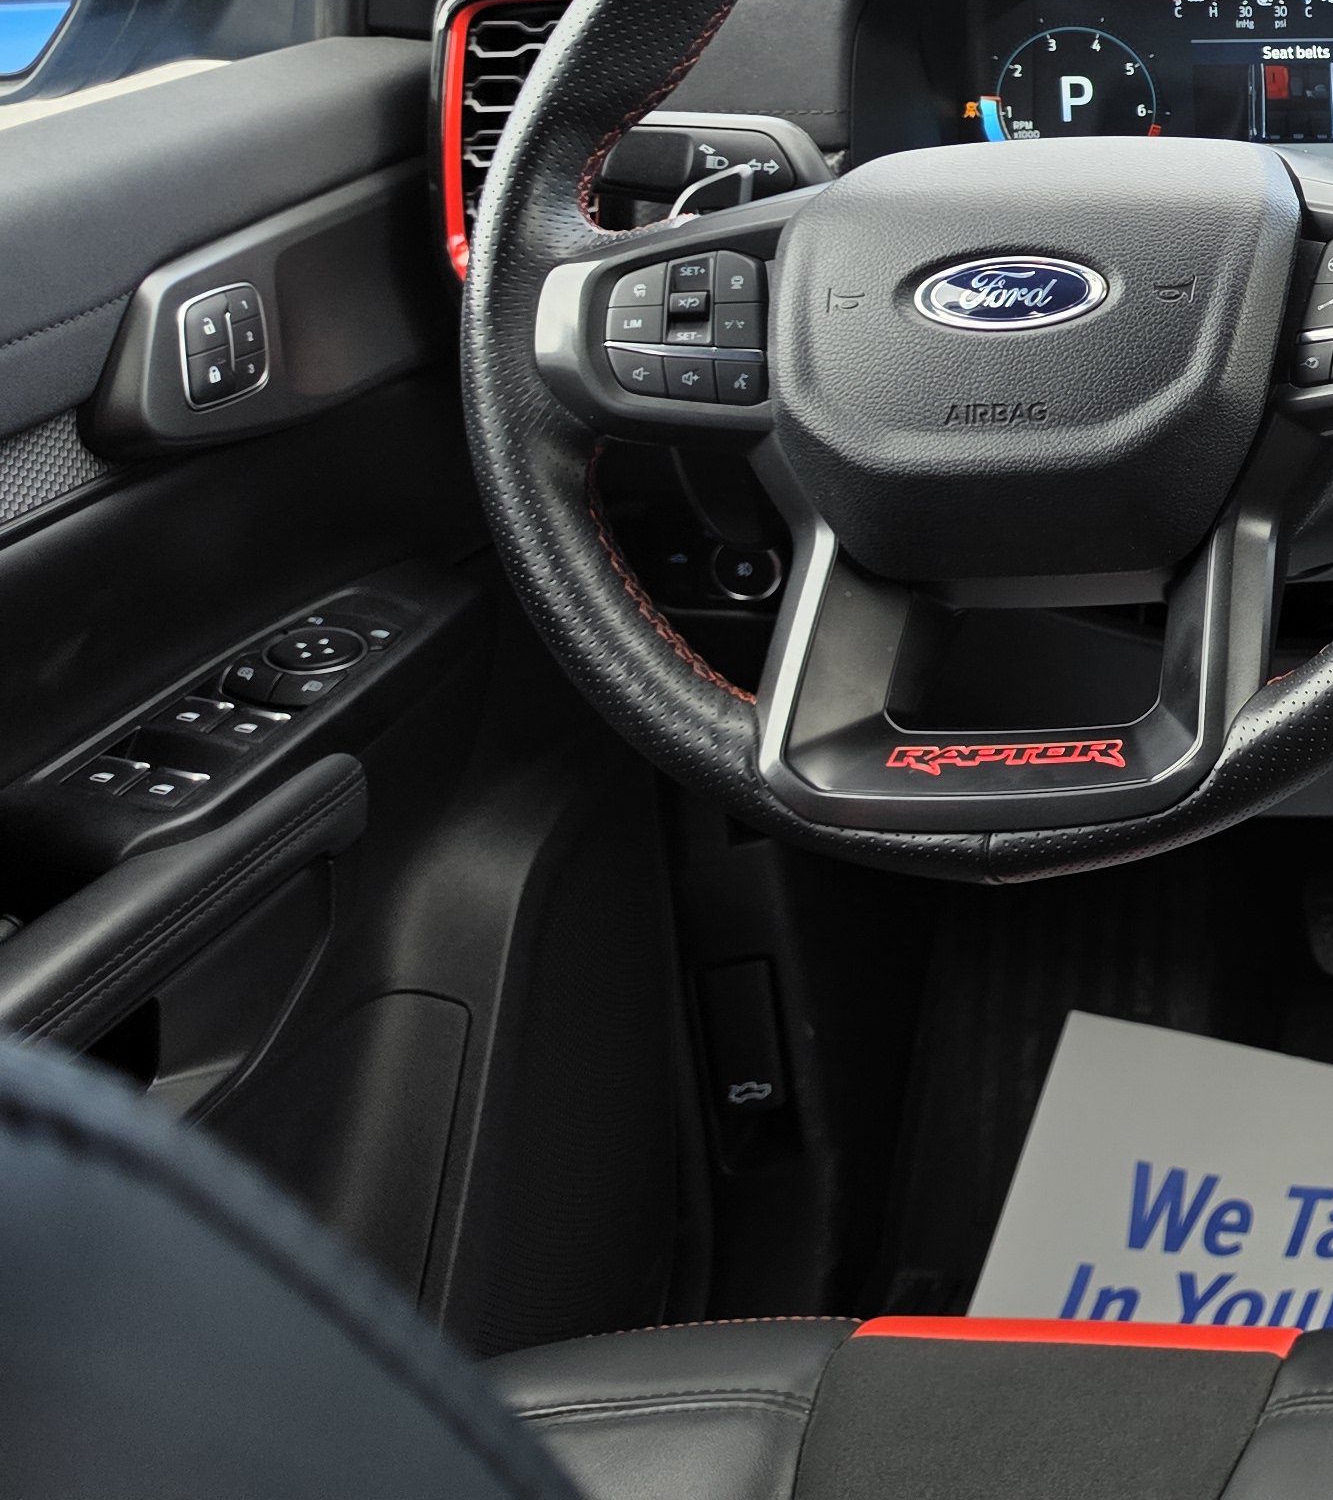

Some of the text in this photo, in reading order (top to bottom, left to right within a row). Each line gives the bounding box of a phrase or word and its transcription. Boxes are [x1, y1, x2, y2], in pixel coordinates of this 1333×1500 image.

[1174, 6, 1183, 18] C
[1208, 6, 1219, 18] H
[1238, 5, 1253, 18] 30
[1274, 5, 1288, 18] 30
[1305, 6, 1313, 18] C
[1274, 18, 1287, 30] psi
[1047, 38, 1057, 52] 3
[1090, 38, 1101, 52] 4
[1262, 44, 1331, 61] Seat belts
[1012, 64, 1023, 77] 2
[1125, 62, 1135, 75] 5
[1060, 75, 1094, 123] P
[1136, 104, 1148, 117] 6
[1012, 120, 1034, 131] RPM
[958, 269, 1056, 312] Ford
[241, 299, 249, 310] 1
[623, 318, 643, 330] LIM
[245, 330, 255, 342] 2
[247, 362, 256, 374] 3
[944, 401, 1049, 426] AIRBAG
[885, 738, 1126, 777] RAPTOR
[1125, 1159, 1254, 1257] We
[1060, 1263, 1141, 1322] In
